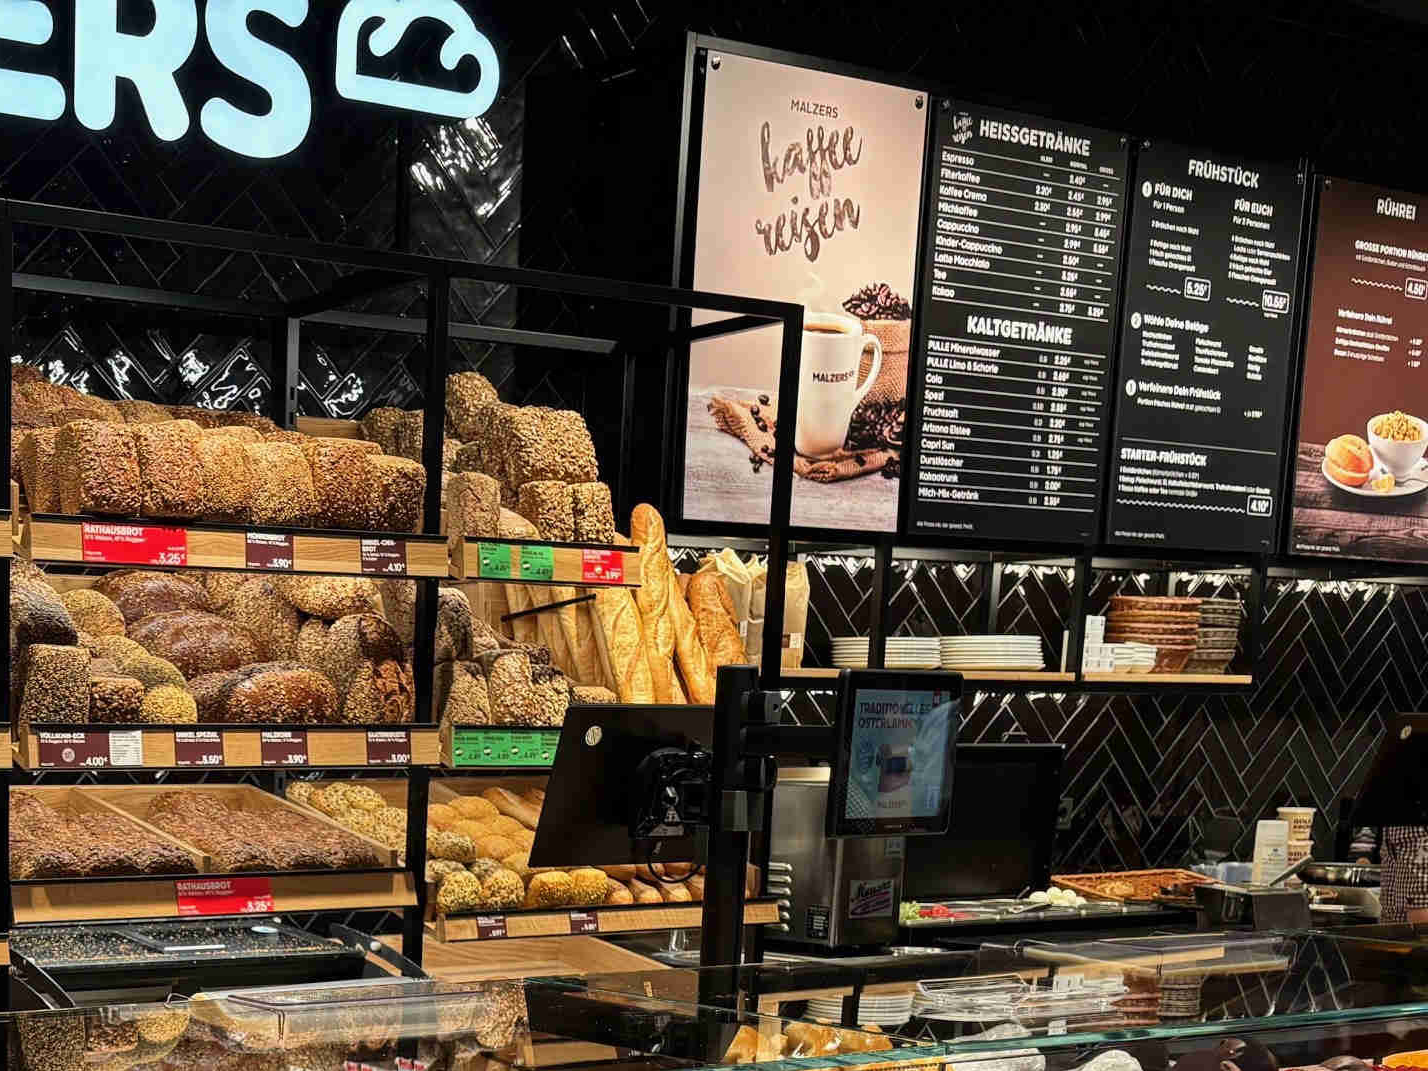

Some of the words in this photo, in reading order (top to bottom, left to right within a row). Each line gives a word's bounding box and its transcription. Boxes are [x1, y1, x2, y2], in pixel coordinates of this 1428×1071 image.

[789, 99, 839, 119] MALZERS
[979, 120, 1091, 157] HEISSGETRÄNKE
[759, 121, 862, 201] kaffee
[942, 151, 974, 166] Espresso
[941, 168, 980, 184] Filterkaffee
[1188, 159, 1259, 189] FRÜHSTÜCK
[939, 185, 964, 199] Kaffee
[963, 189, 987, 202] Crema
[1154, 182, 1170, 197] FÜR
[1172, 186, 1193, 201] DICH
[938, 202, 978, 218] Milchkaffee
[1234, 199, 1250, 213] FÜR
[1251, 202, 1273, 217] EUCH
[1377, 197, 1416, 221] RÜHREI
[746, 196, 860, 263] reisen
[937, 218, 979, 235] Cappuccino
[935, 235, 1003, 255] Kinder-Cappuccino
[1355, 240, 1379, 254] GROSSE
[1408, 248, 1428, 262] RÜHRE
[934, 268, 947, 280] Tee
[967, 316, 1072, 345] KALTGETRÄNKE
[813, 371, 849, 384] MALZERS
[925, 373, 943, 384] Cola
[924, 390, 944, 402] Spezi
[923, 406, 959, 419] Fruchtsaft
[921, 438, 940, 451] Capri
[920, 455, 963, 468] Durstlöscher
[1120, 448, 1207, 467] STARTER-FRÜHSTÜCK
[918, 488, 979, 501] Milch-Mix-Getränk
